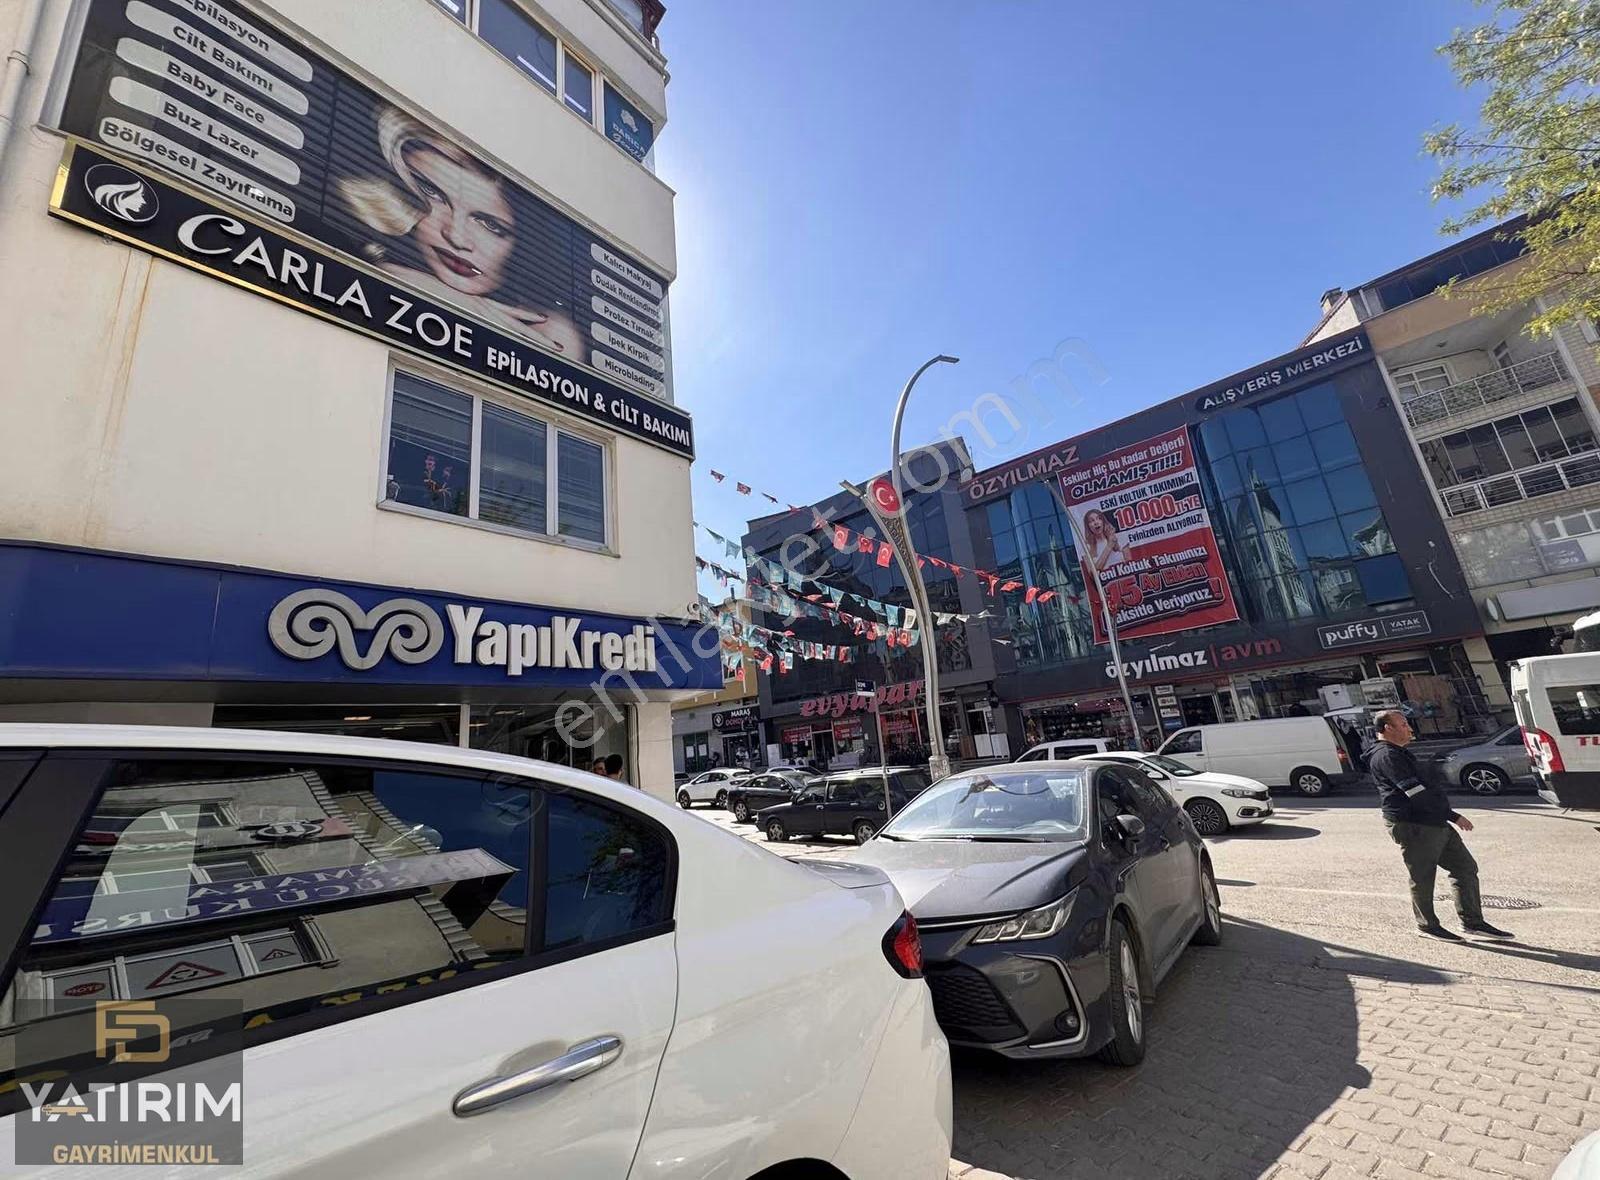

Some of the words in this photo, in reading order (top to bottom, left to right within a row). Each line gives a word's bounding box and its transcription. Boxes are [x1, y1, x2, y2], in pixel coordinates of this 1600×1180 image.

[185, 0, 269, 51] pilasyon
[172, 25, 208, 53] Cilt
[211, 47, 274, 92] Bakımı
[166, 60, 219, 98] Baby
[223, 93, 266, 124] Face
[102, 120, 198, 171] Bölgesel
[163, 101, 204, 131] Buz
[207, 121, 260, 160] Lazer
[595, 274, 617, 294] Dudak
[603, 252, 625, 273] Kalıcı
[626, 267, 652, 290] Makyaj
[177, 213, 373, 319] CARLA
[385, 294, 473, 358] ZOE
[486, 346, 589, 406] EPİLASYON
[593, 392, 606, 413] &
[610, 398, 640, 426] CİLT
[642, 413, 691, 447] BAKIMI
[603, 305, 630, 328] Protez
[629, 319, 655, 340] Tırnak
[608, 330, 627, 353] İpek
[604, 358, 656, 392] Microblading
[1203, 370, 1282, 410] ALIŞVERİŞ
[1285, 336, 1364, 378] MERKEZİ
[969, 444, 1080, 500] ÖZYILMAZ
[1062, 469, 1091, 487] Eskiler
[1092, 464, 1107, 477] Hiç
[1108, 459, 1121, 471] Bu
[1121, 449, 1149, 468] Kadar
[1100, 494, 1118, 511] ESKİ
[1119, 487, 1147, 506] KOLTUK
[1114, 493, 1176, 530] 10.000
[1099, 569, 1117, 582] eni
[1117, 558, 1152, 577] Koltuk
[1152, 546, 1208, 567] Takımınızı
[1116, 604, 1155, 625] aksitle
[1154, 587, 1213, 613] Veriyoruz
[446, 604, 657, 676] YapıKredi
[1325, 623, 1379, 646] puffy
[1390, 617, 1421, 629] YATAK
[1105, 649, 1209, 680] özyılmaz
[1221, 638, 1282, 662] avm
